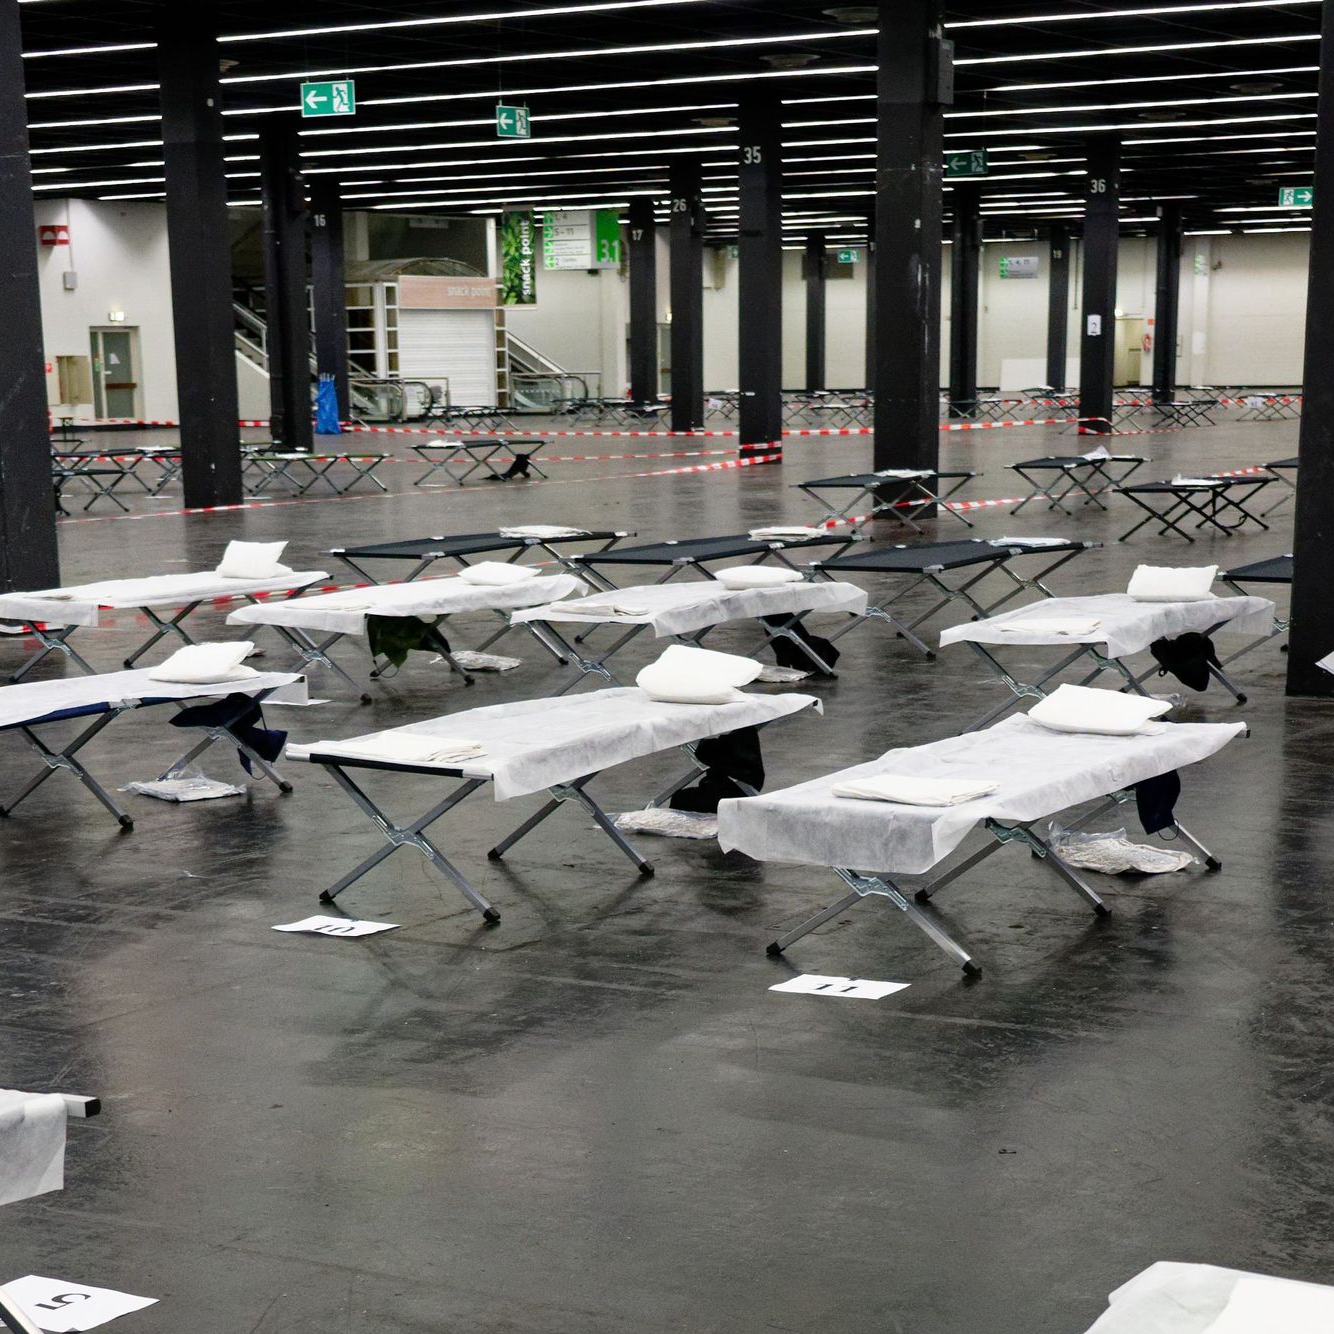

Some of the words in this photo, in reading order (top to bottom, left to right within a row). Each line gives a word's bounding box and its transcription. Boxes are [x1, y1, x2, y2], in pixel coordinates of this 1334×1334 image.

[744, 146, 761, 164] 35
[1090, 178, 1106, 193] 36
[673, 199, 687, 212] 26
[313, 214, 326, 226] 16
[520, 220, 533, 255] point
[632, 229, 643, 240] 17
[600, 240, 620, 263] 3.1
[520, 259, 531, 295] snack
[447, 286, 468, 297] snack
[471, 286, 492, 298] point
[314, 924, 356, 934] 10
[813, 983, 859, 993] 11
[34, 1293, 92, 1311] 5
